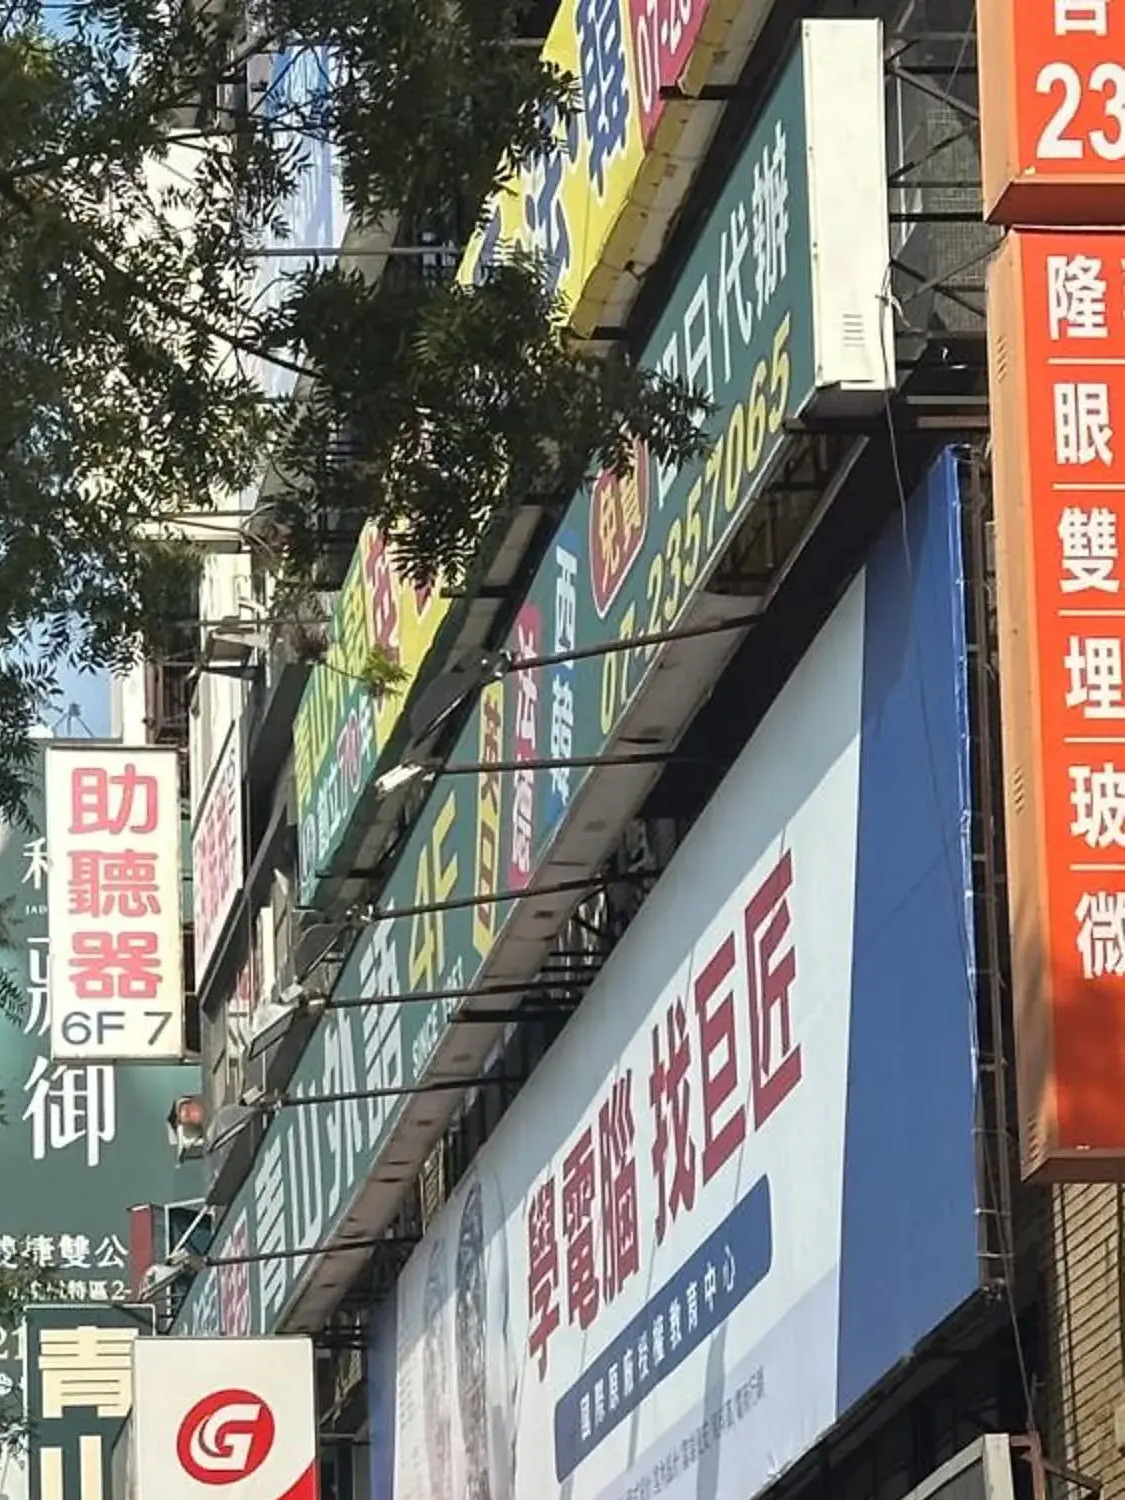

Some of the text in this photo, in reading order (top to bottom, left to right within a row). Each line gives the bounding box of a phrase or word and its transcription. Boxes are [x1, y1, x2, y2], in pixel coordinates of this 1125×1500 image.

[67, 764, 163, 1000] 助聽器
[409, 789, 459, 993] 4F
[61, 1011, 126, 1046] 6F
[254, 896, 405, 1336] 青山外語
[524, 1066, 640, 1383] 學電腦
[648, 849, 803, 1249] 找巨匠
